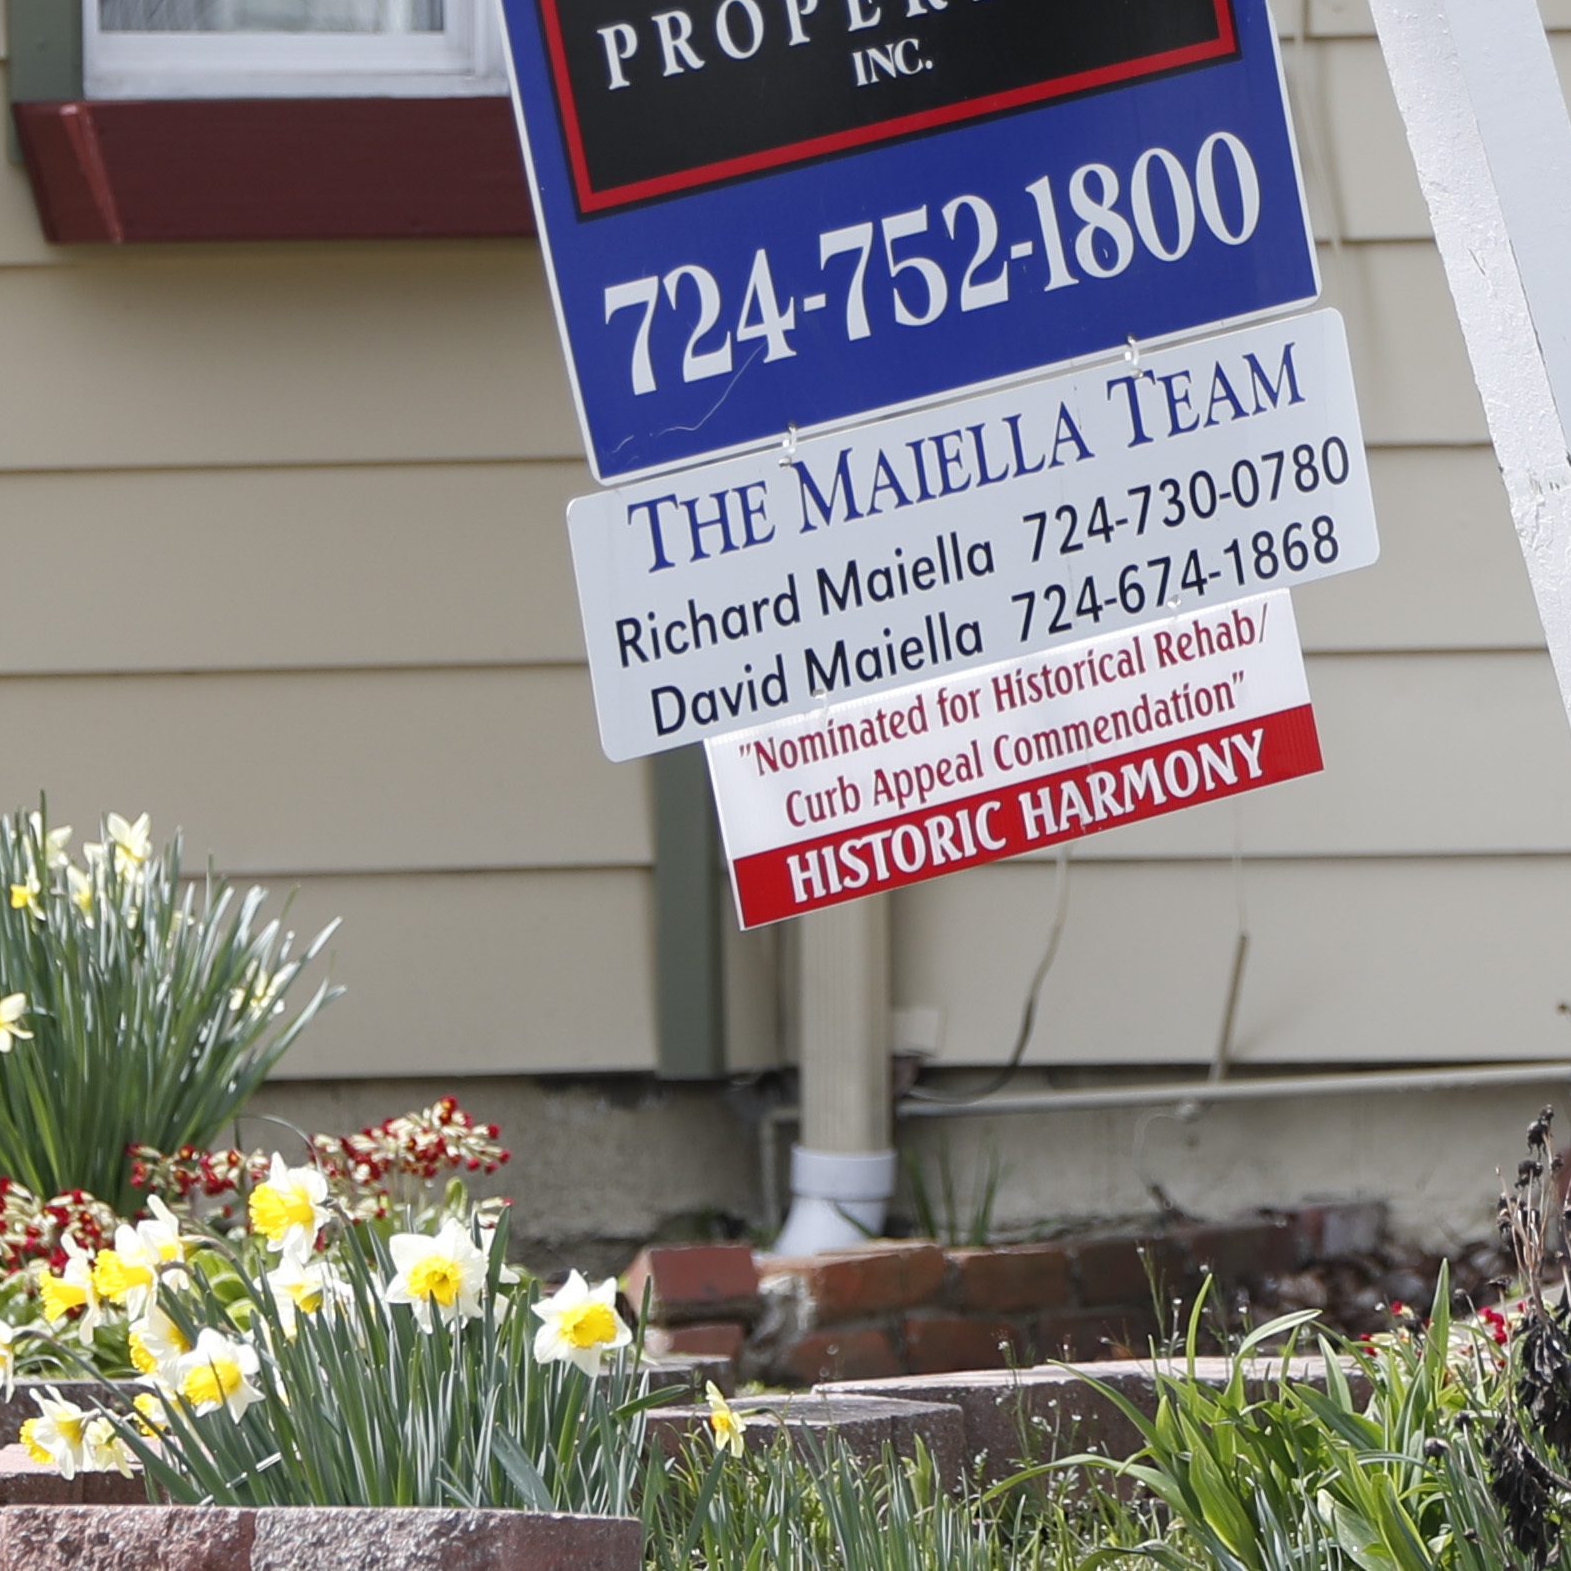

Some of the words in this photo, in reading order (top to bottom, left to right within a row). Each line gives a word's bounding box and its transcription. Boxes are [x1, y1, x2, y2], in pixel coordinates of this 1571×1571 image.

[851, 38, 934, 88] INC.
[604, 131, 1261, 396] 724-752-1800
[615, 573, 800, 668] Richard
[819, 531, 995, 616] Maiella
[1023, 434, 1350, 563] 724-730-0780
[628, 493, 777, 574] THE
[792, 399, 1094, 532] MAIELLA
[1107, 342, 1305, 449] TEAM
[651, 654, 789, 737] David
[805, 612, 984, 696] Maiella
[1012, 515, 1341, 643] 724-674-1868
[740, 694, 928, 776] "Nominated
[937, 687, 981, 728] for
[991, 636, 1146, 712] Historical
[786, 776, 861, 827] Curb
[874, 740, 984, 810] Appeal
[994, 670, 1245, 771] Commendation"
[786, 800, 1007, 904] HISTORIC
[1019, 728, 1264, 841] HARMONY
